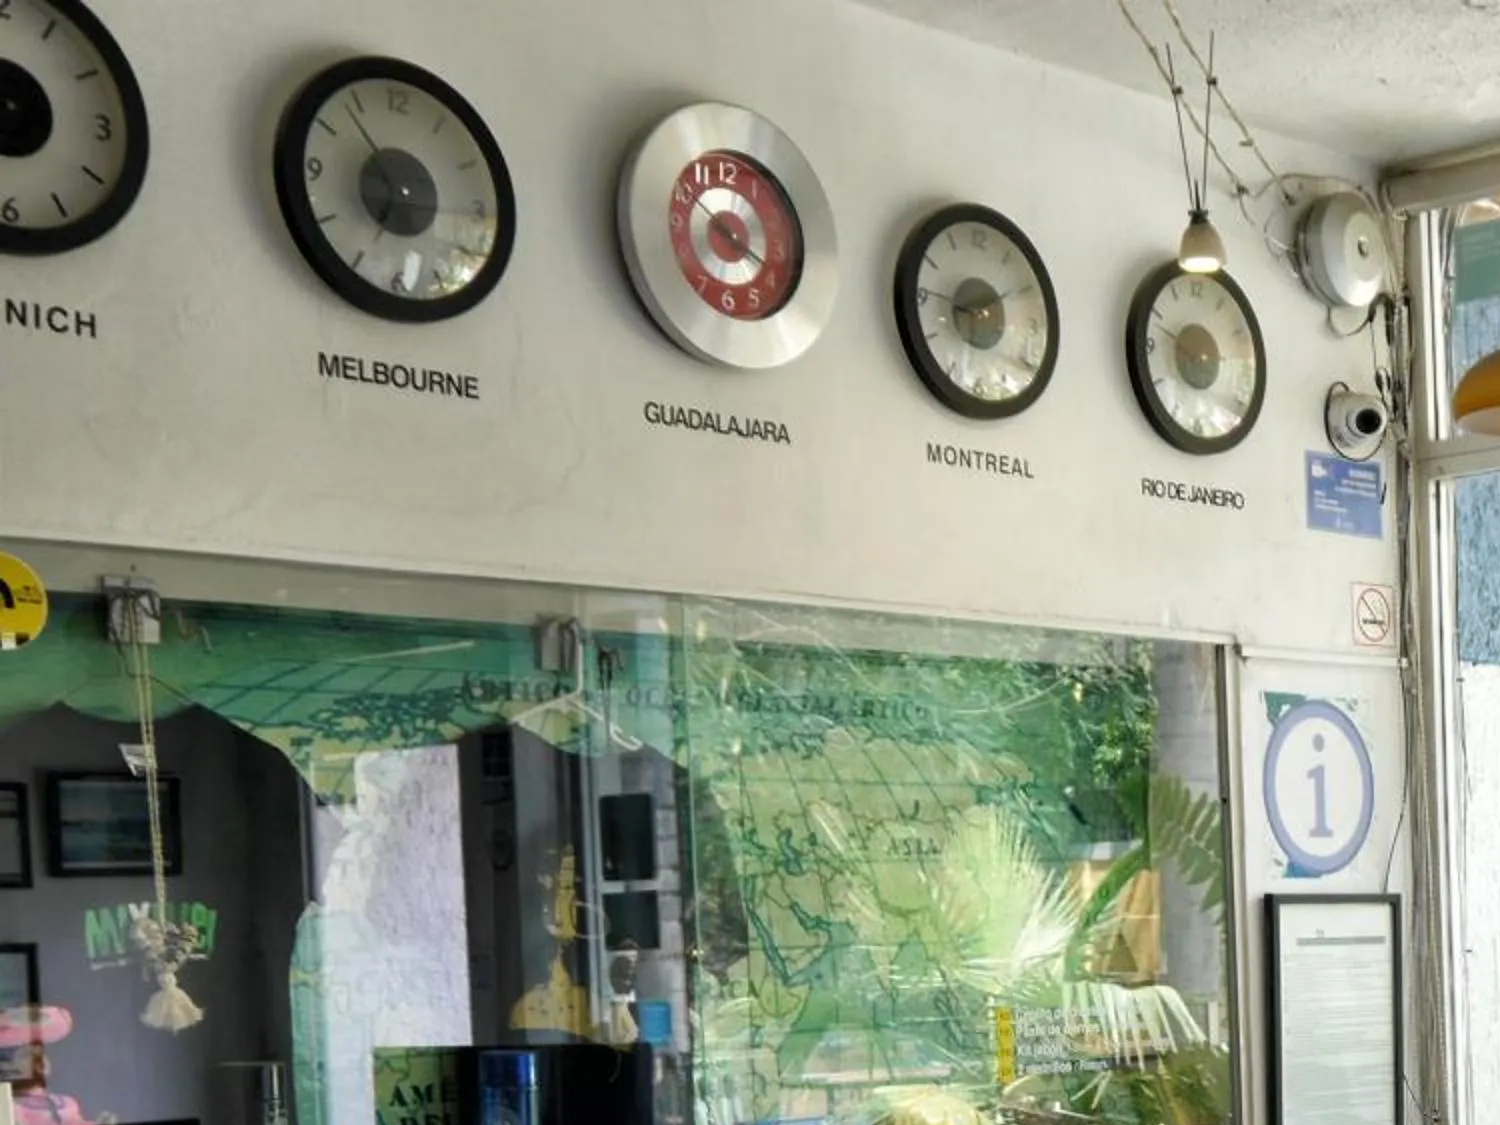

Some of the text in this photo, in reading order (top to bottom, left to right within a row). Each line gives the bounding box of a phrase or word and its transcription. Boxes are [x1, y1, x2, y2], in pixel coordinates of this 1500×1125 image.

[95, 114, 111, 141] 3
[307, 156, 323, 182] 9
[718, 160, 737, 186] 12
[2, 196, 20, 223] 6
[720, 289, 736, 311] 6
[317, 351, 480, 400] MELBOURNE
[643, 401, 792, 445] GUADALAJARA
[926, 442, 1035, 480] MONTREAL
[1140, 477, 1246, 509] RIO DE JANEIRO
